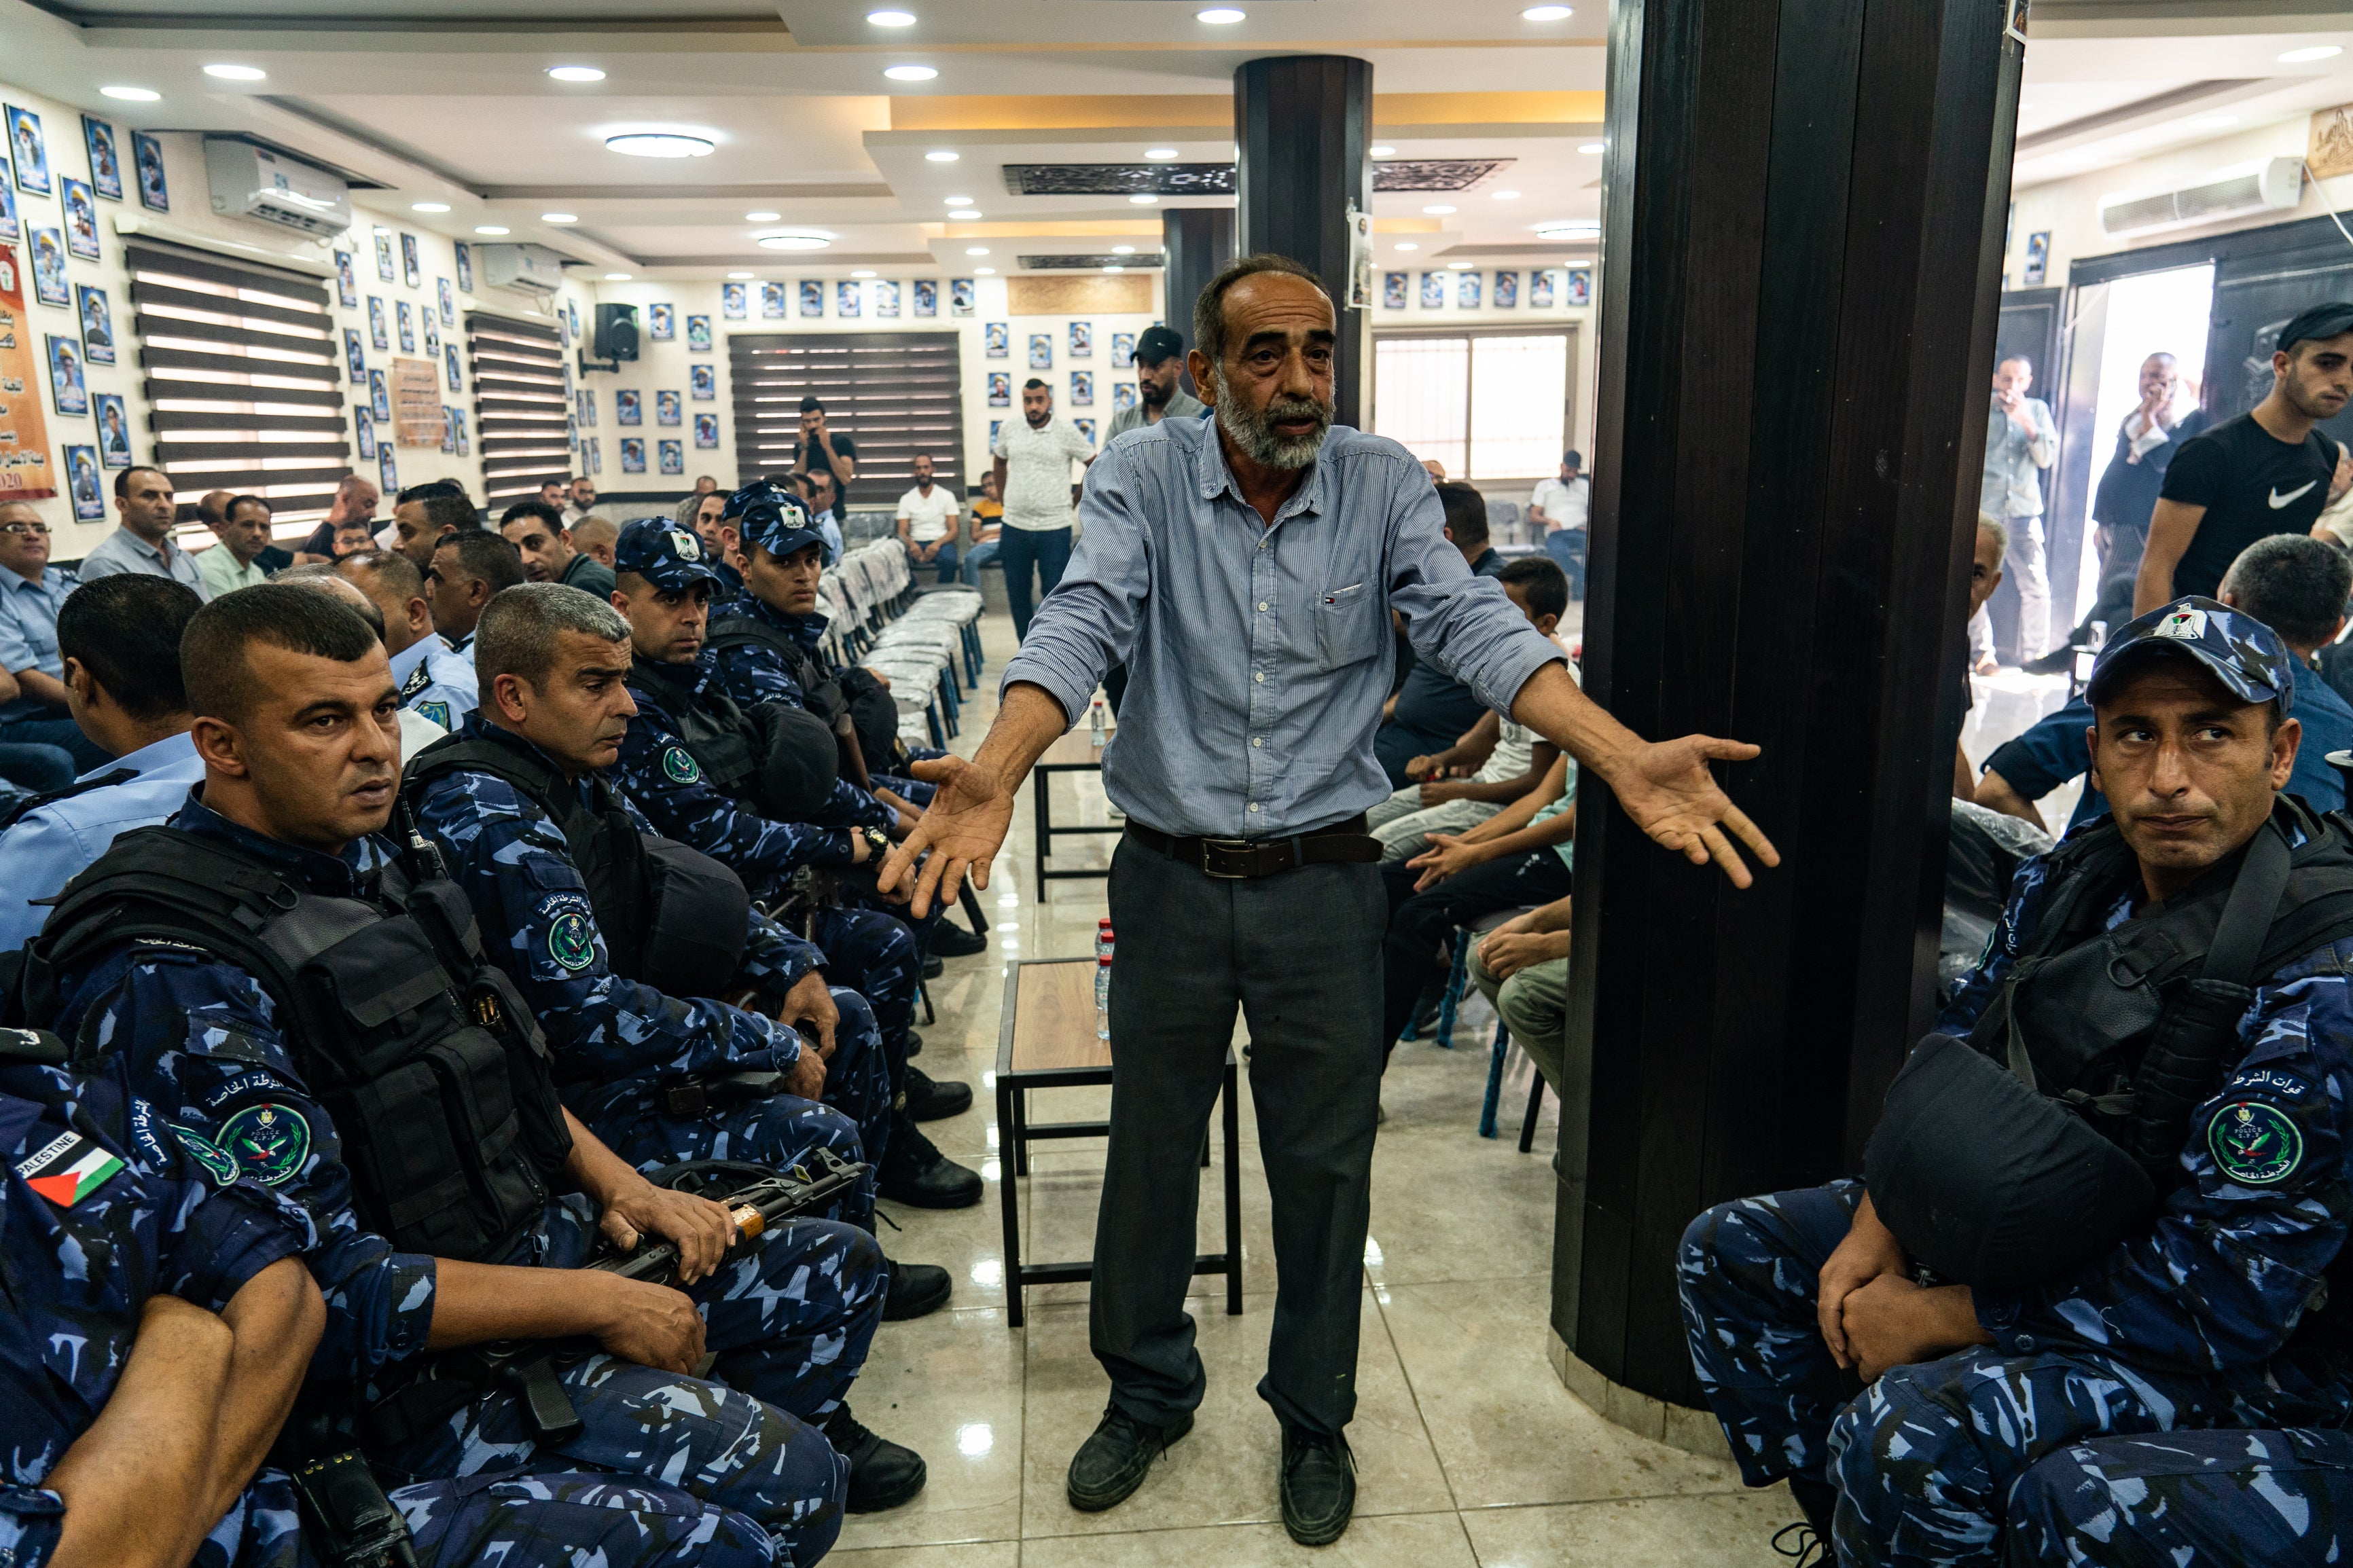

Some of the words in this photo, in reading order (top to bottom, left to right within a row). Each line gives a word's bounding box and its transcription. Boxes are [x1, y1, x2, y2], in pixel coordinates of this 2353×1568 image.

[2231, 1070, 2271, 1087] الشرط
[2271, 1077, 2305, 1095] قوات
[205, 1078, 249, 1107] الخاصة
[17, 1135, 76, 1175] PALESTINE
